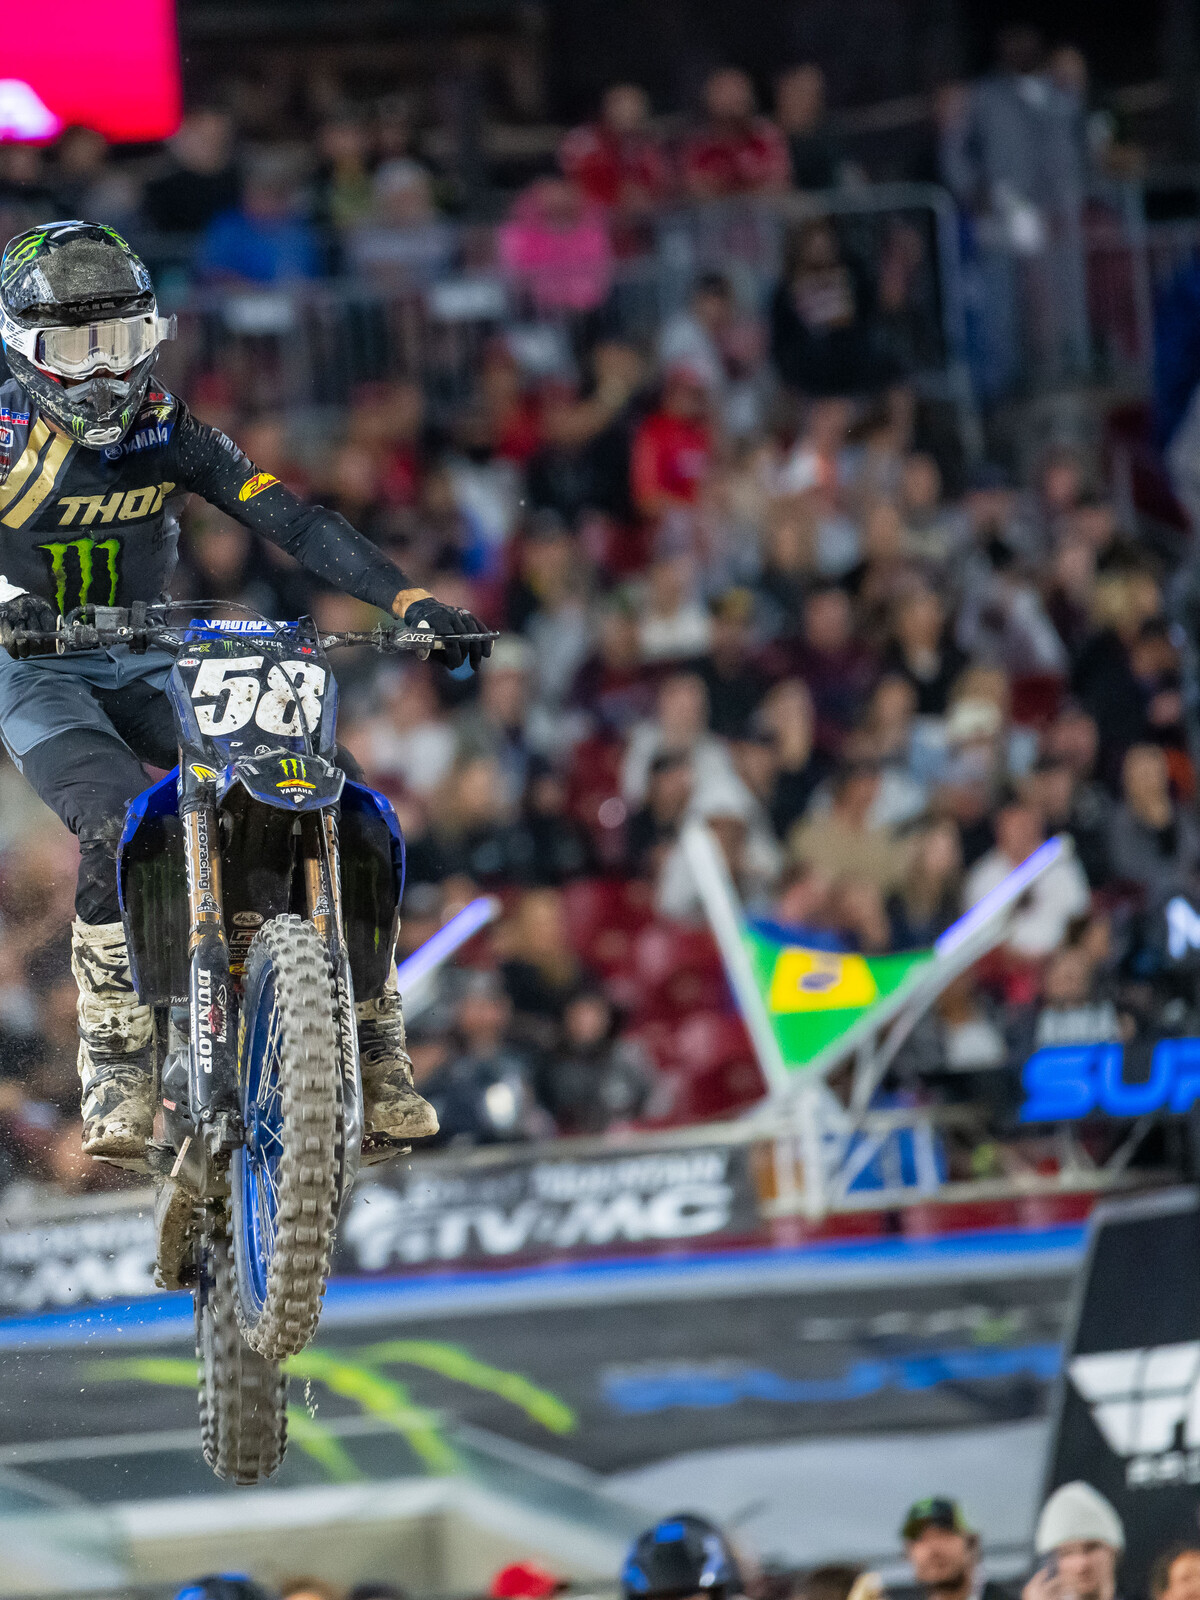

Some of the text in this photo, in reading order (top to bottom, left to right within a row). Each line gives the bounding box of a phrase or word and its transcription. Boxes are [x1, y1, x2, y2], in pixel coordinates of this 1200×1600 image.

[236, 638, 284, 649] MNSTER
[397, 633, 435, 643] ARC
[191, 655, 326, 737] 58
[280, 787, 314, 796] YAMAHA
[197, 967, 213, 1074] DUNLOP
